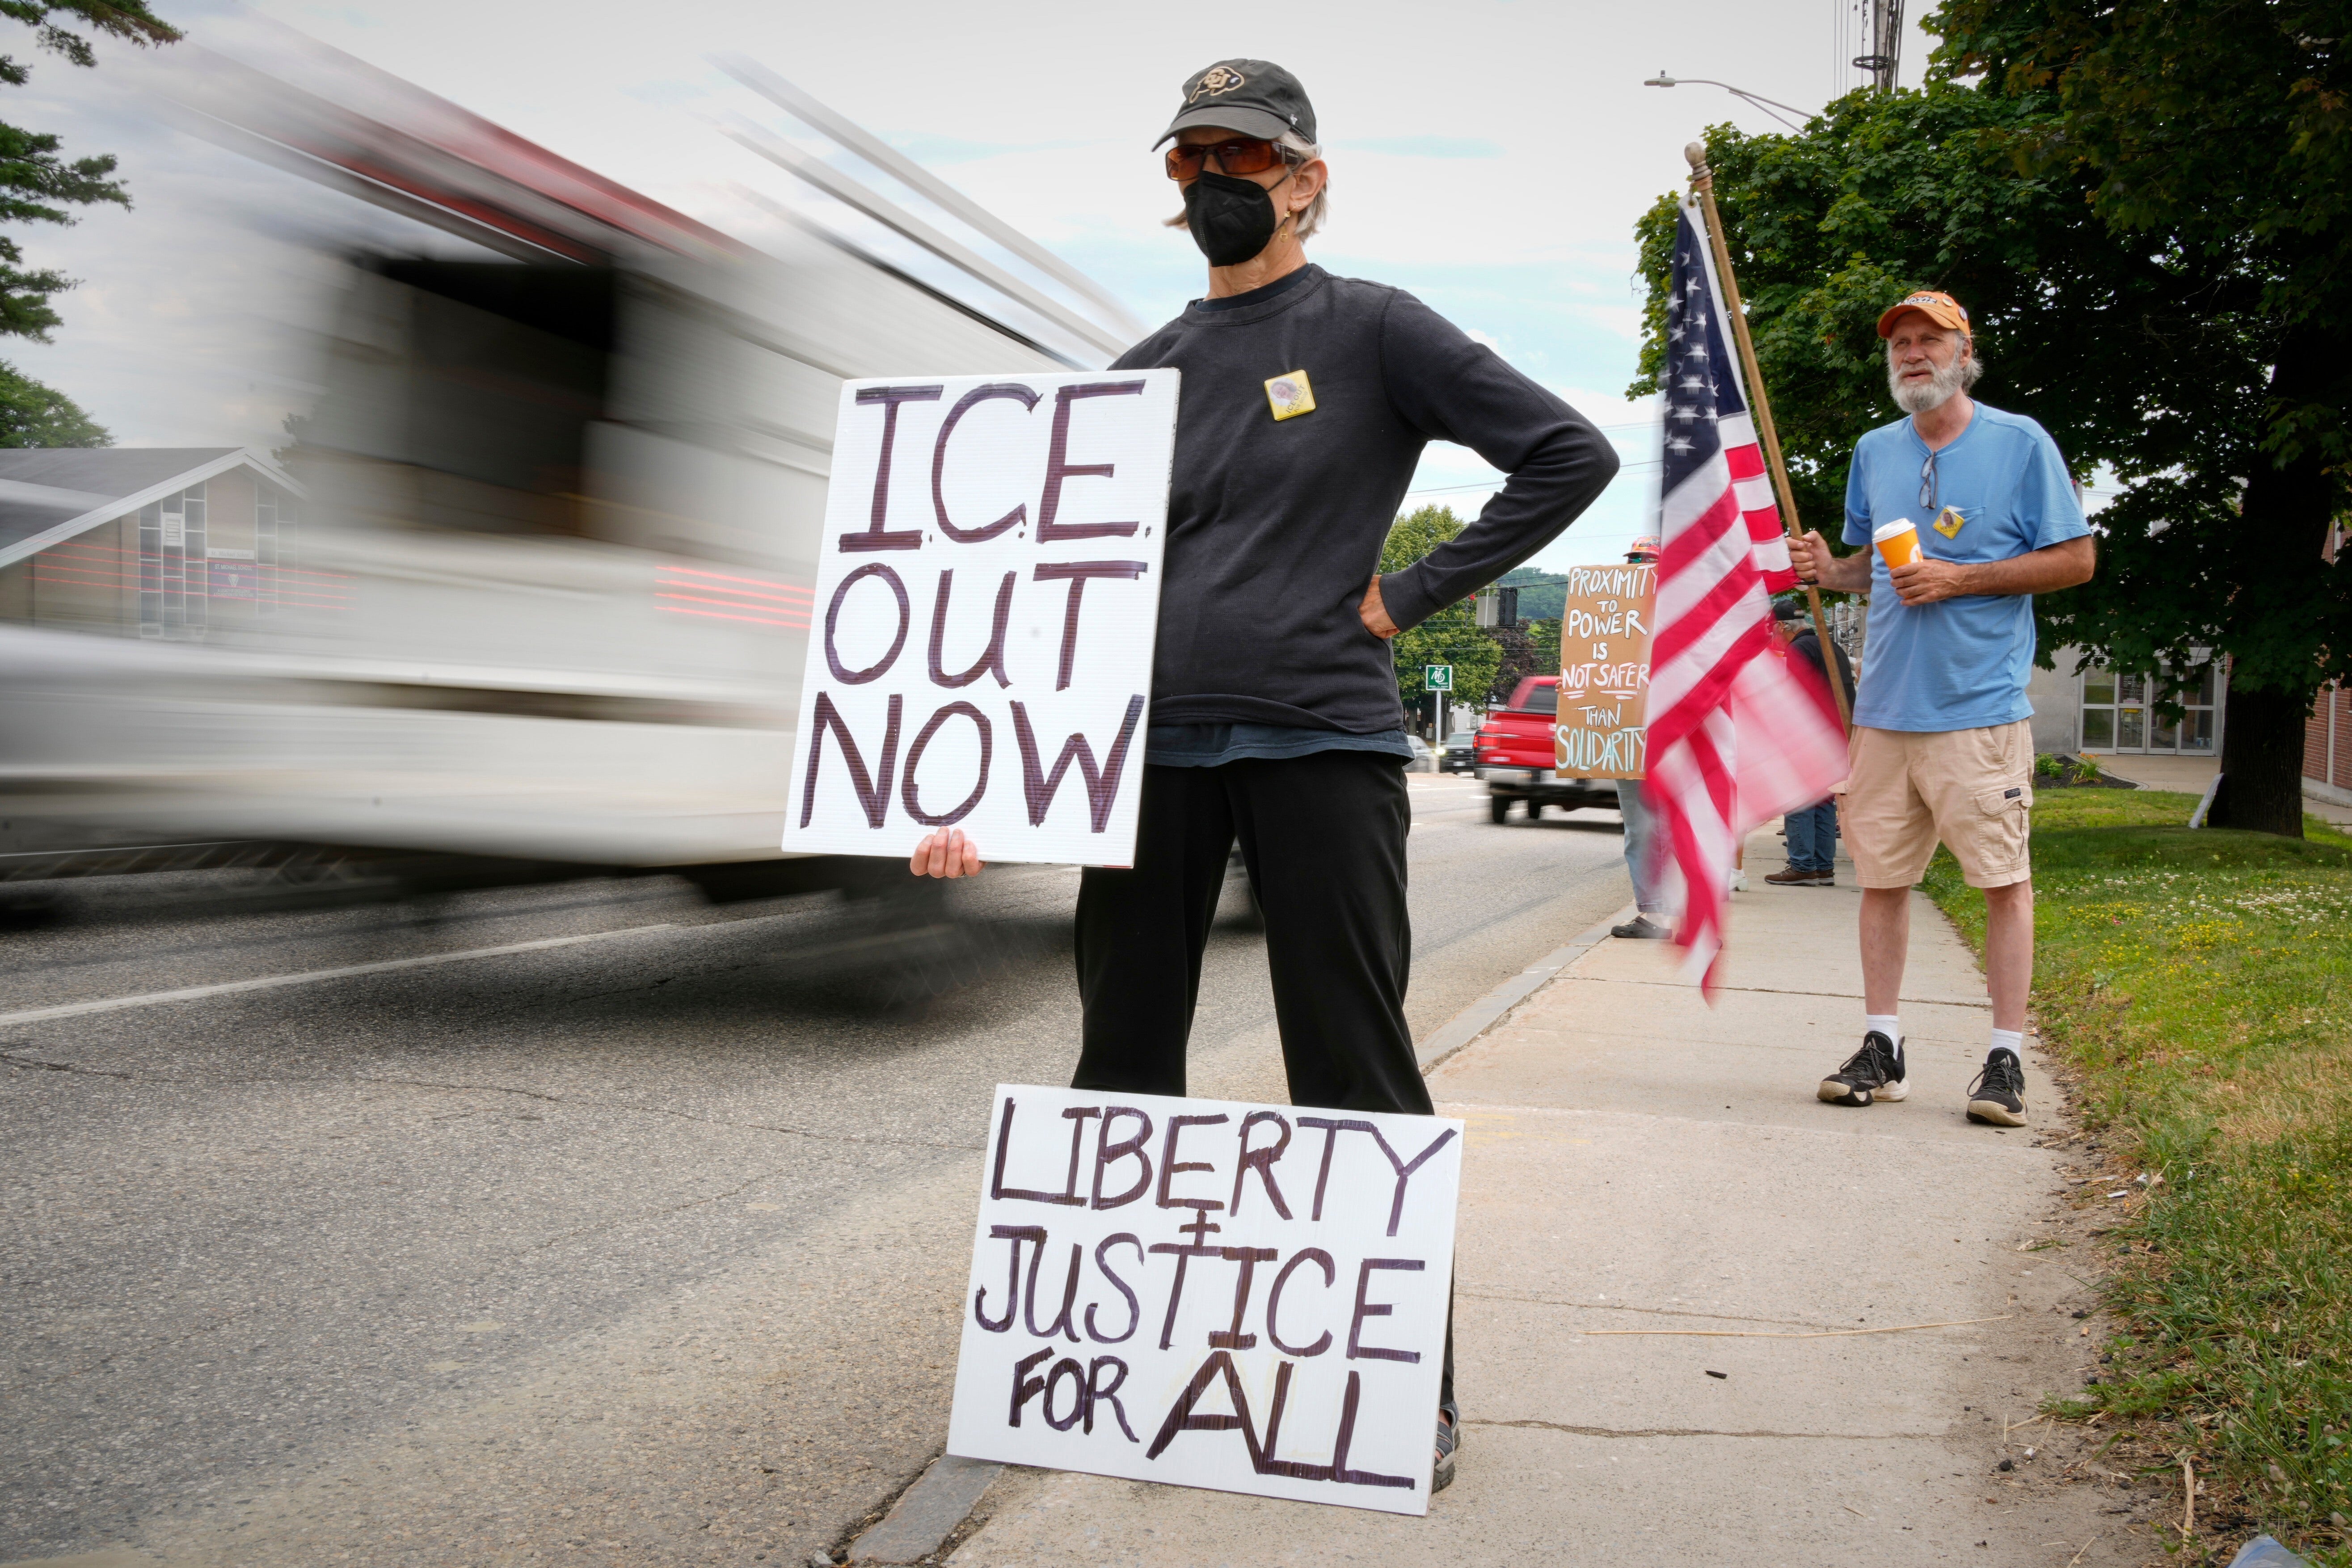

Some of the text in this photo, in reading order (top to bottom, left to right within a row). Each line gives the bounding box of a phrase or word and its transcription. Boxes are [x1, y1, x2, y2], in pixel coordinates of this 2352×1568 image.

[1286, 384, 1305, 413] ICE OUT
[1569, 564, 1658, 599] PROXIMITY
[1568, 608, 1649, 639] POWER
[1596, 599, 1618, 613] TO
[824, 560, 1148, 691] OUT
[1592, 642, 1608, 661] IS
[1562, 662, 1650, 690] NOT SAFER
[1577, 702, 1621, 729] THAN
[800, 691, 1145, 834] NOW
[1555, 725, 1648, 773] SOLIDARITY
[990, 1096, 1458, 1237] LIBERTY
[975, 1225, 1425, 1364] JUSTICE
[1008, 1346, 1416, 1491] FOR ALL
